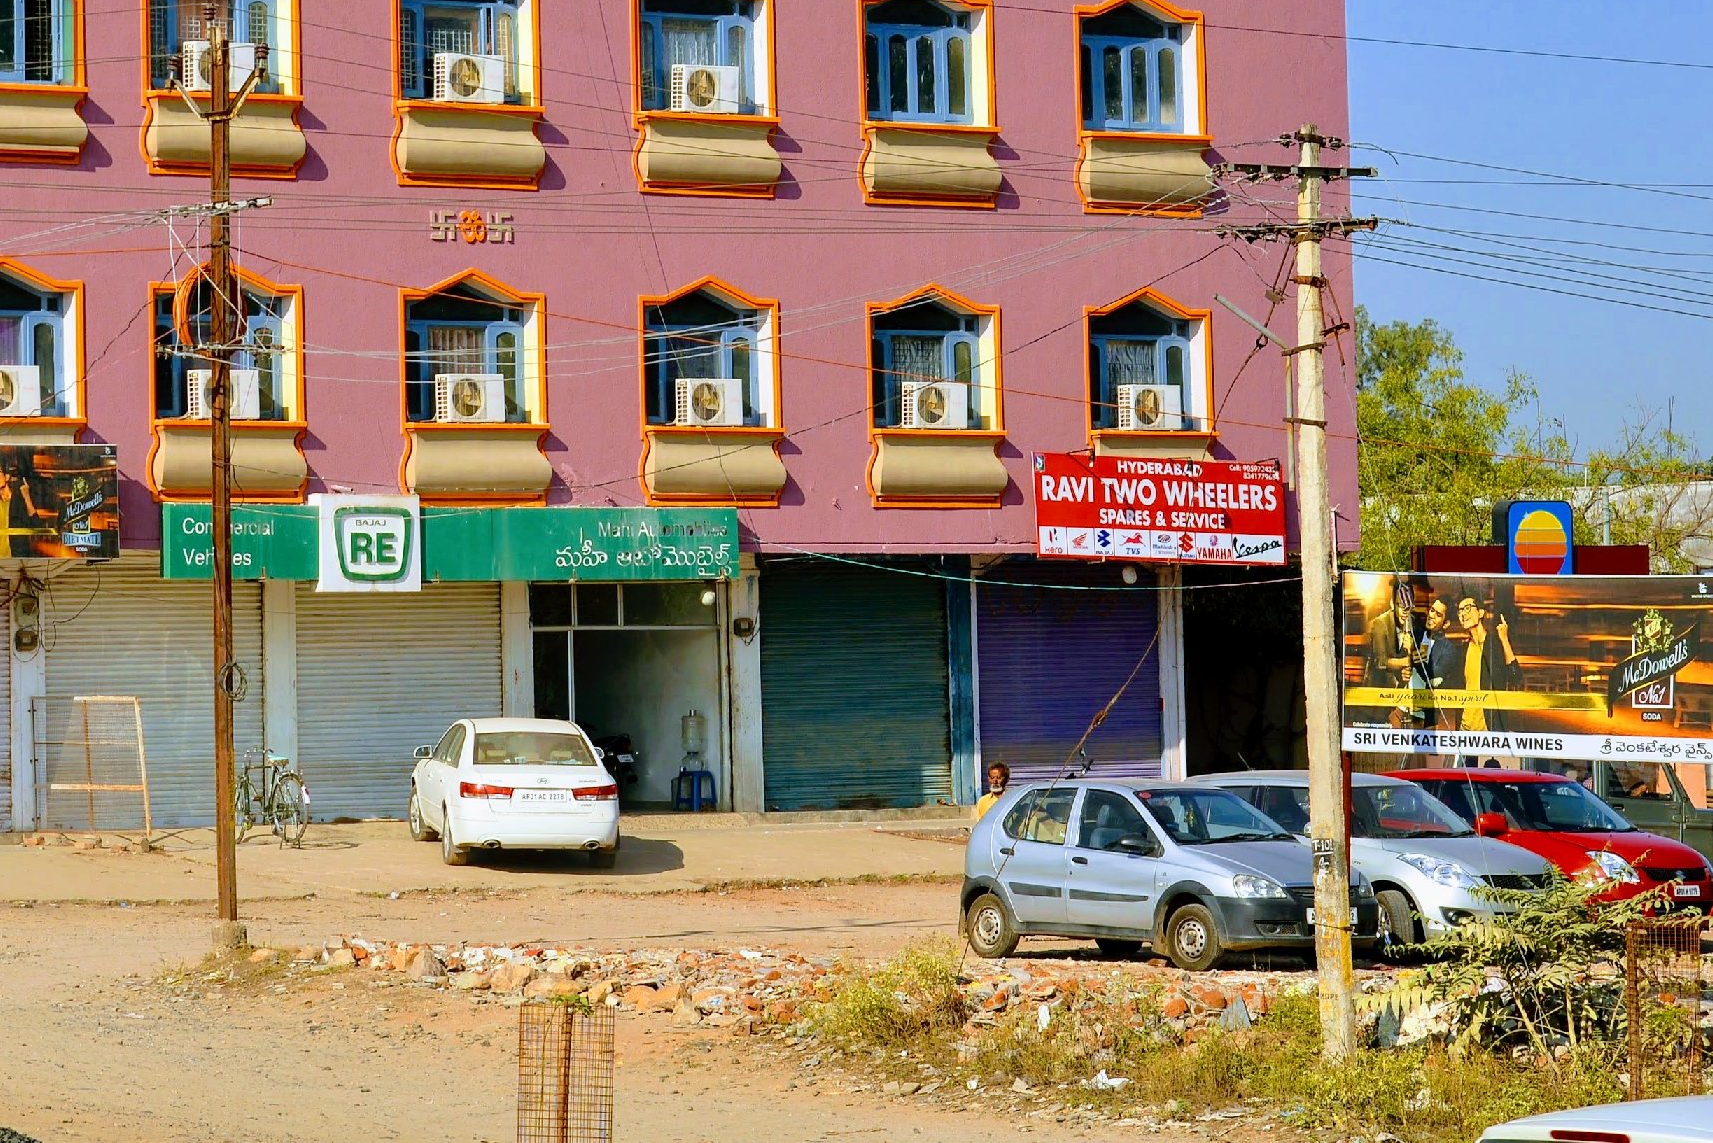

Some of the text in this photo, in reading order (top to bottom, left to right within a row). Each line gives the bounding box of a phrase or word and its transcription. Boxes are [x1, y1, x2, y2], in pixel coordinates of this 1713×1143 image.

[1117, 459, 1202, 478] HYDERABAD
[1041, 474, 1278, 512] RAVI TWO WHEELERS
[183, 518, 275, 535] Comercial
[356, 519, 387, 527] BAJAJ
[1099, 508, 1226, 530] SPARES & SERVICE
[183, 548, 252, 566] Vehes
[351, 532, 397, 565] RE
[1125, 547, 1141, 555] TVS
[1196, 547, 1233, 560] YAMAHA
[1232, 536, 1283, 559] Vespa
[1618, 639, 1688, 693] McDowell's
[1642, 712, 1662, 720] SODA
[1353, 732, 1563, 752] SRI VENKATESHWARA WINES
